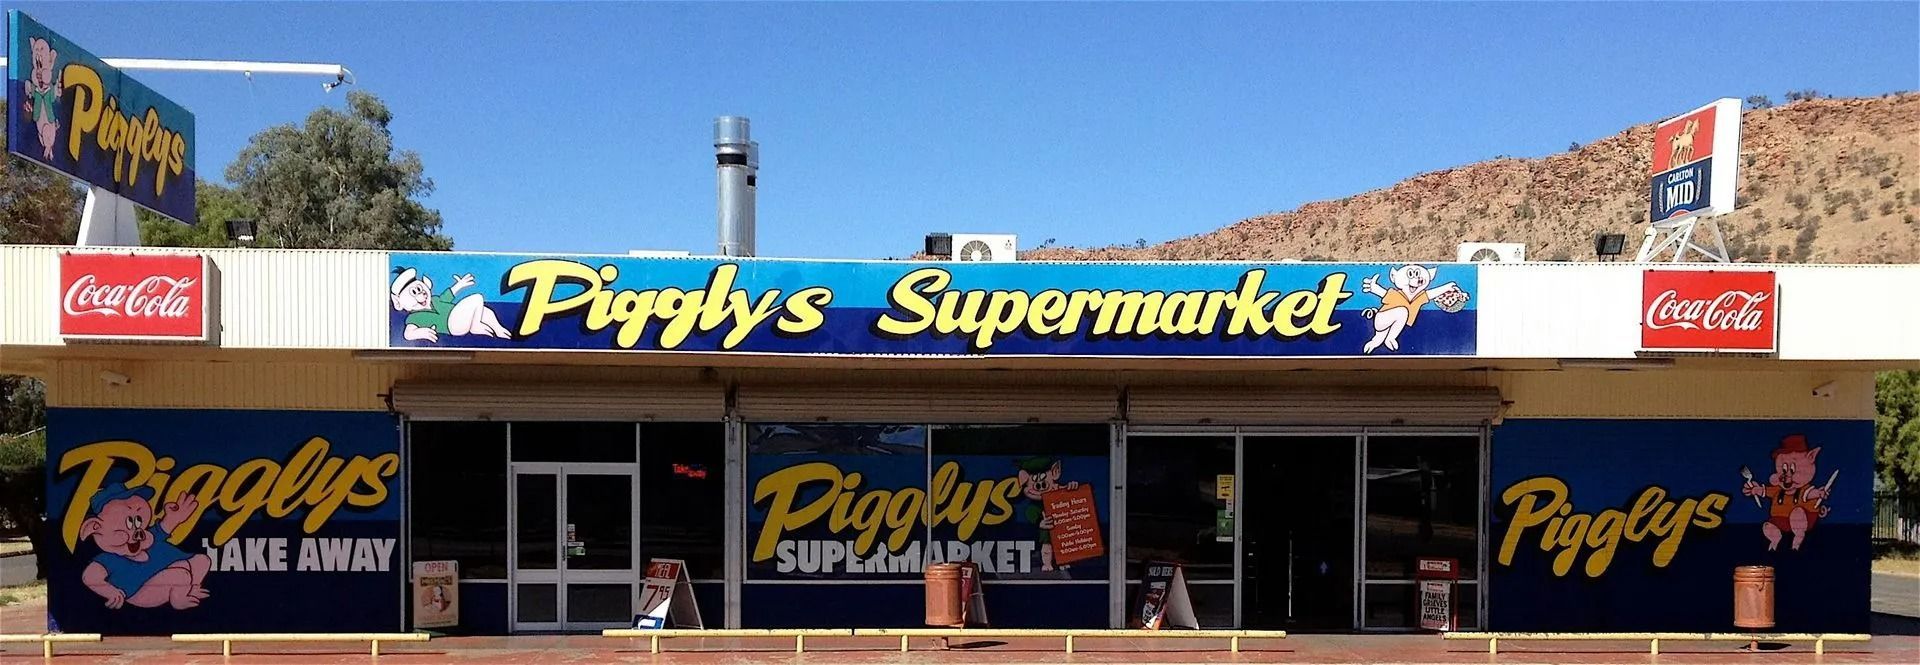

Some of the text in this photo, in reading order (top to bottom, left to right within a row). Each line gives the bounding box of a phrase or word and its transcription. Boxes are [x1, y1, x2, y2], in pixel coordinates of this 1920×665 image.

[62, 63, 186, 196] Pigglys
[1666, 181, 1695, 213] MID
[1668, 167, 1694, 185] CARLTON
[63, 274, 197, 318] Coca-Cola
[508, 259, 1353, 349] Pigglys Supermarket
[1646, 289, 1771, 332] Coca-Cola
[60, 437, 399, 554] Pigglys
[753, 461, 1019, 563] Pigglys
[1497, 477, 1730, 578] Pigglys
[297, 537, 396, 572] AWAY
[425, 562, 449, 573] OPEN
[1423, 600, 1448, 608] GRIEVES
[1425, 592, 1446, 601] FAMILY
